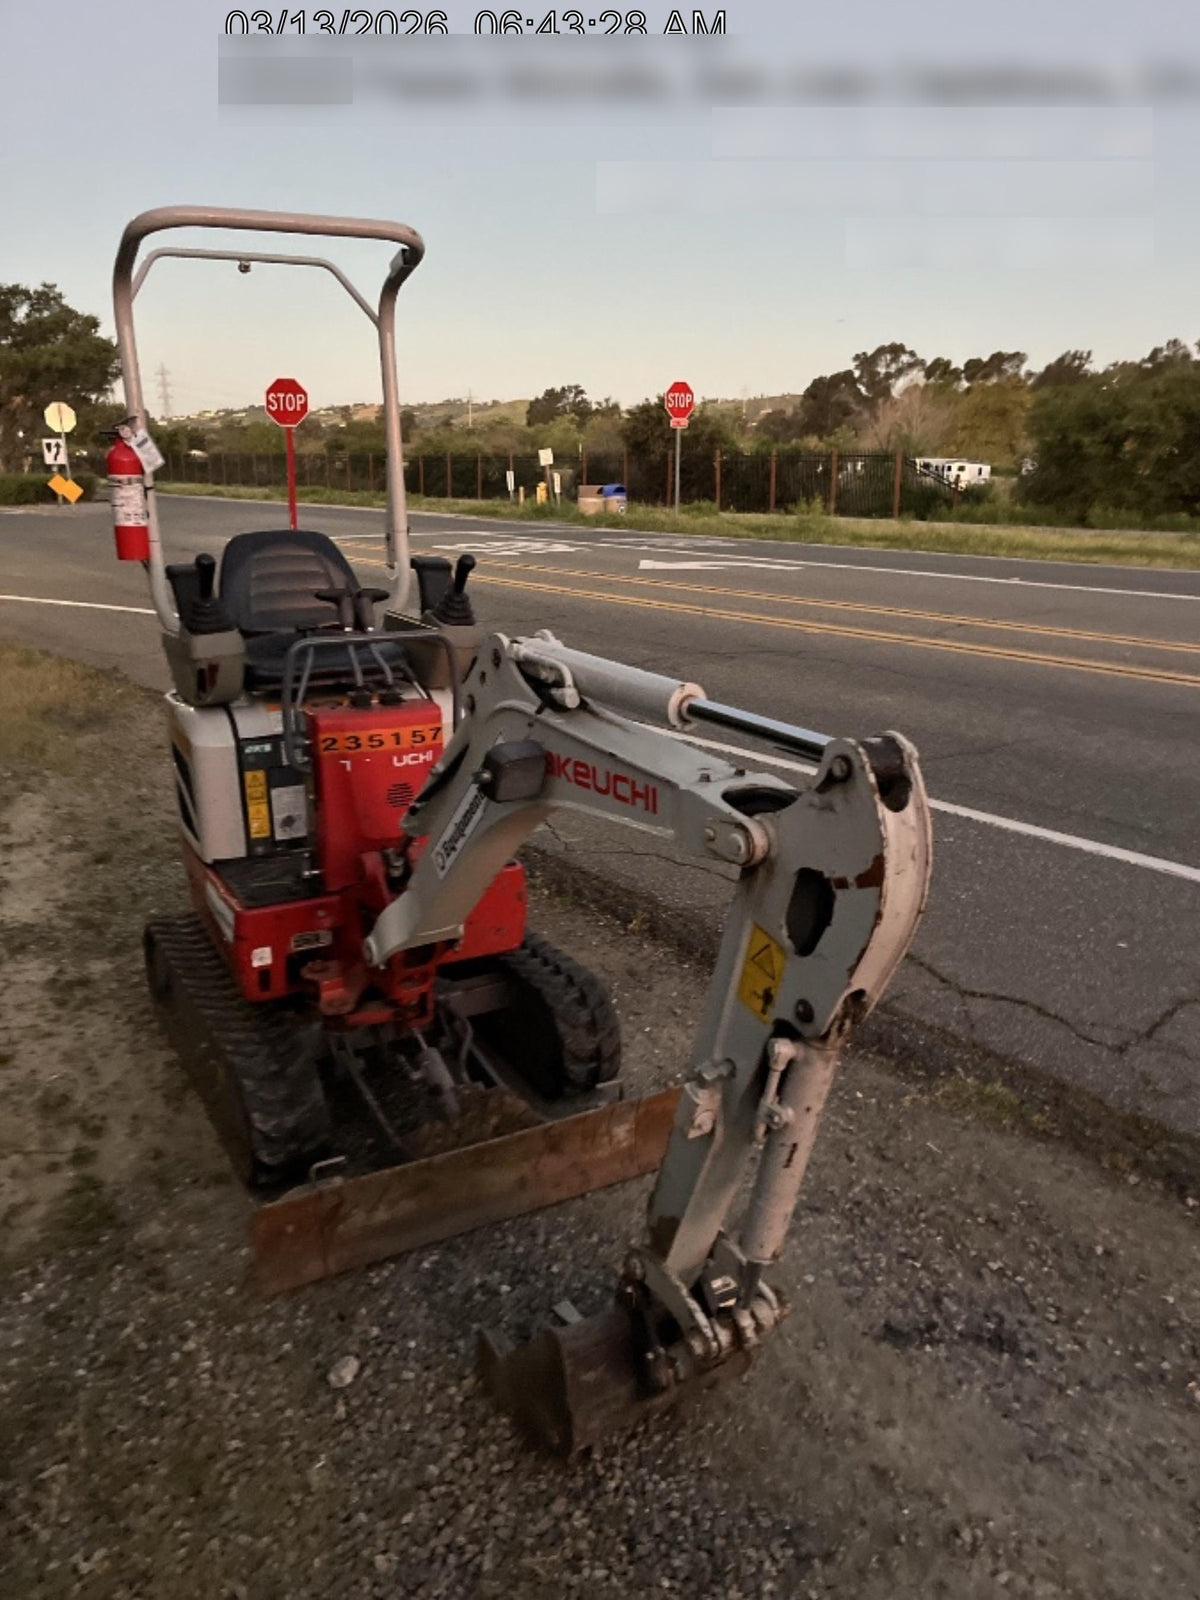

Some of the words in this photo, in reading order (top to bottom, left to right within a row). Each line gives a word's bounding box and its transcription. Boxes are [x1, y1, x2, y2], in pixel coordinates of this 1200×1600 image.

[267, 393, 306, 411] STOP
[668, 392, 692, 408] STOP
[321, 727, 442, 751] 235157
